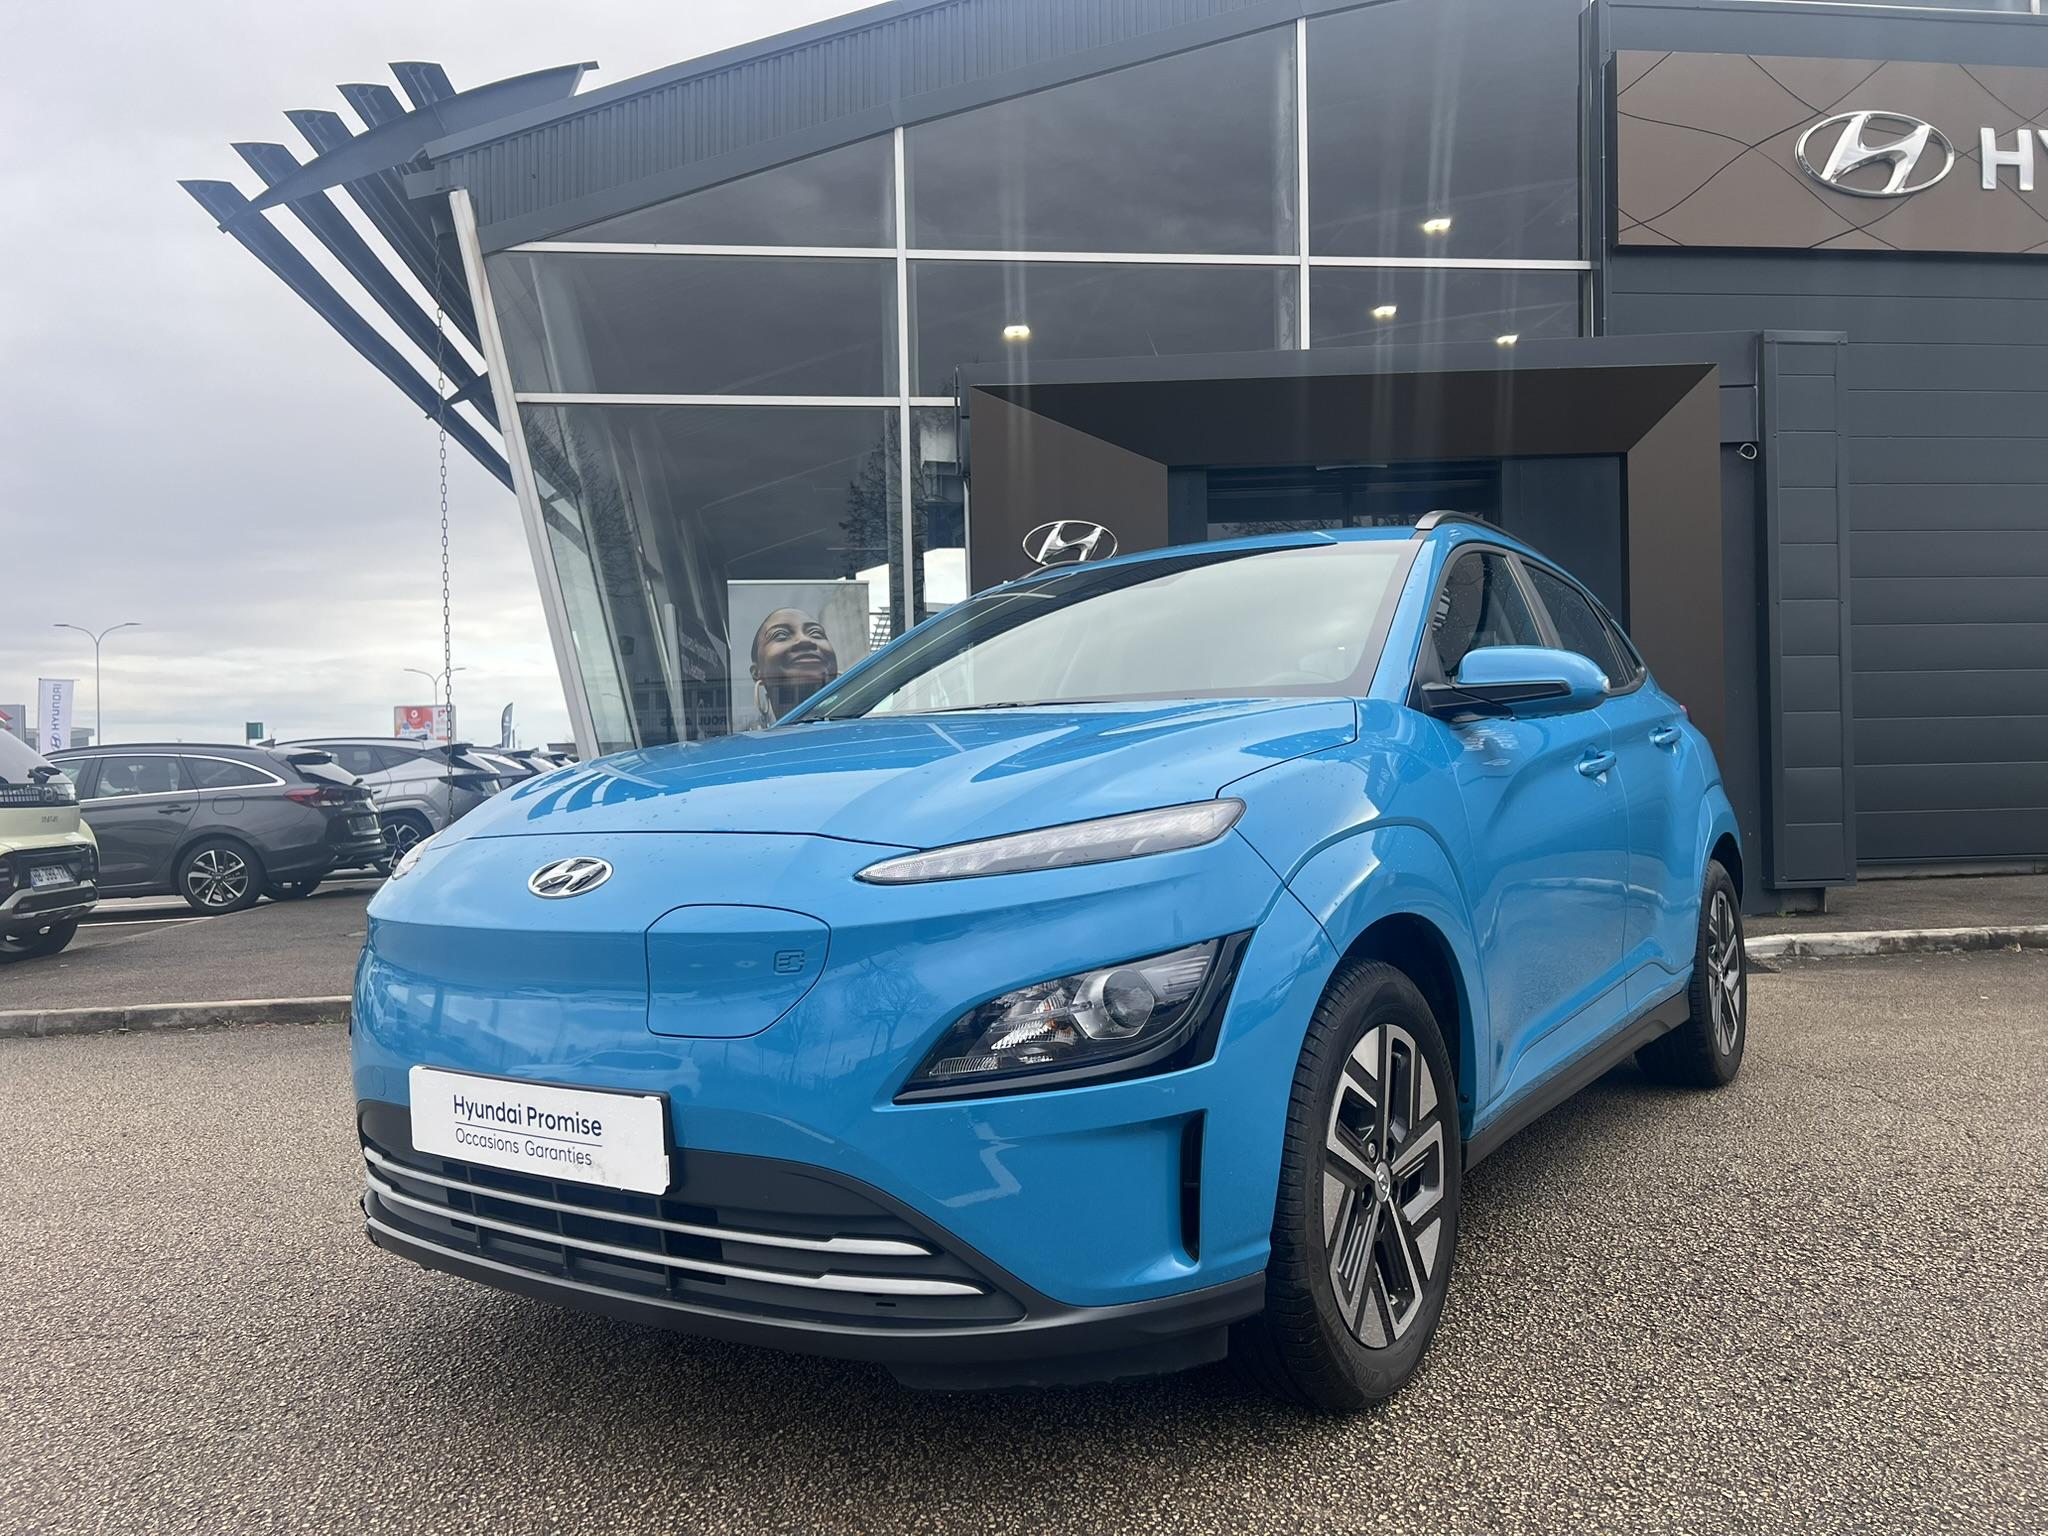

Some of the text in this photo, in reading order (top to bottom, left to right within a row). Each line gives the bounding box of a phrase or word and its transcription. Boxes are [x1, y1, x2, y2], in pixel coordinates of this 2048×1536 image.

[1981, 127, 2048, 191] H
[51, 683, 63, 731] HYUNDAI
[453, 1094, 603, 1137] Hyundai Promise
[455, 1127, 593, 1166] Occasions Garanties
